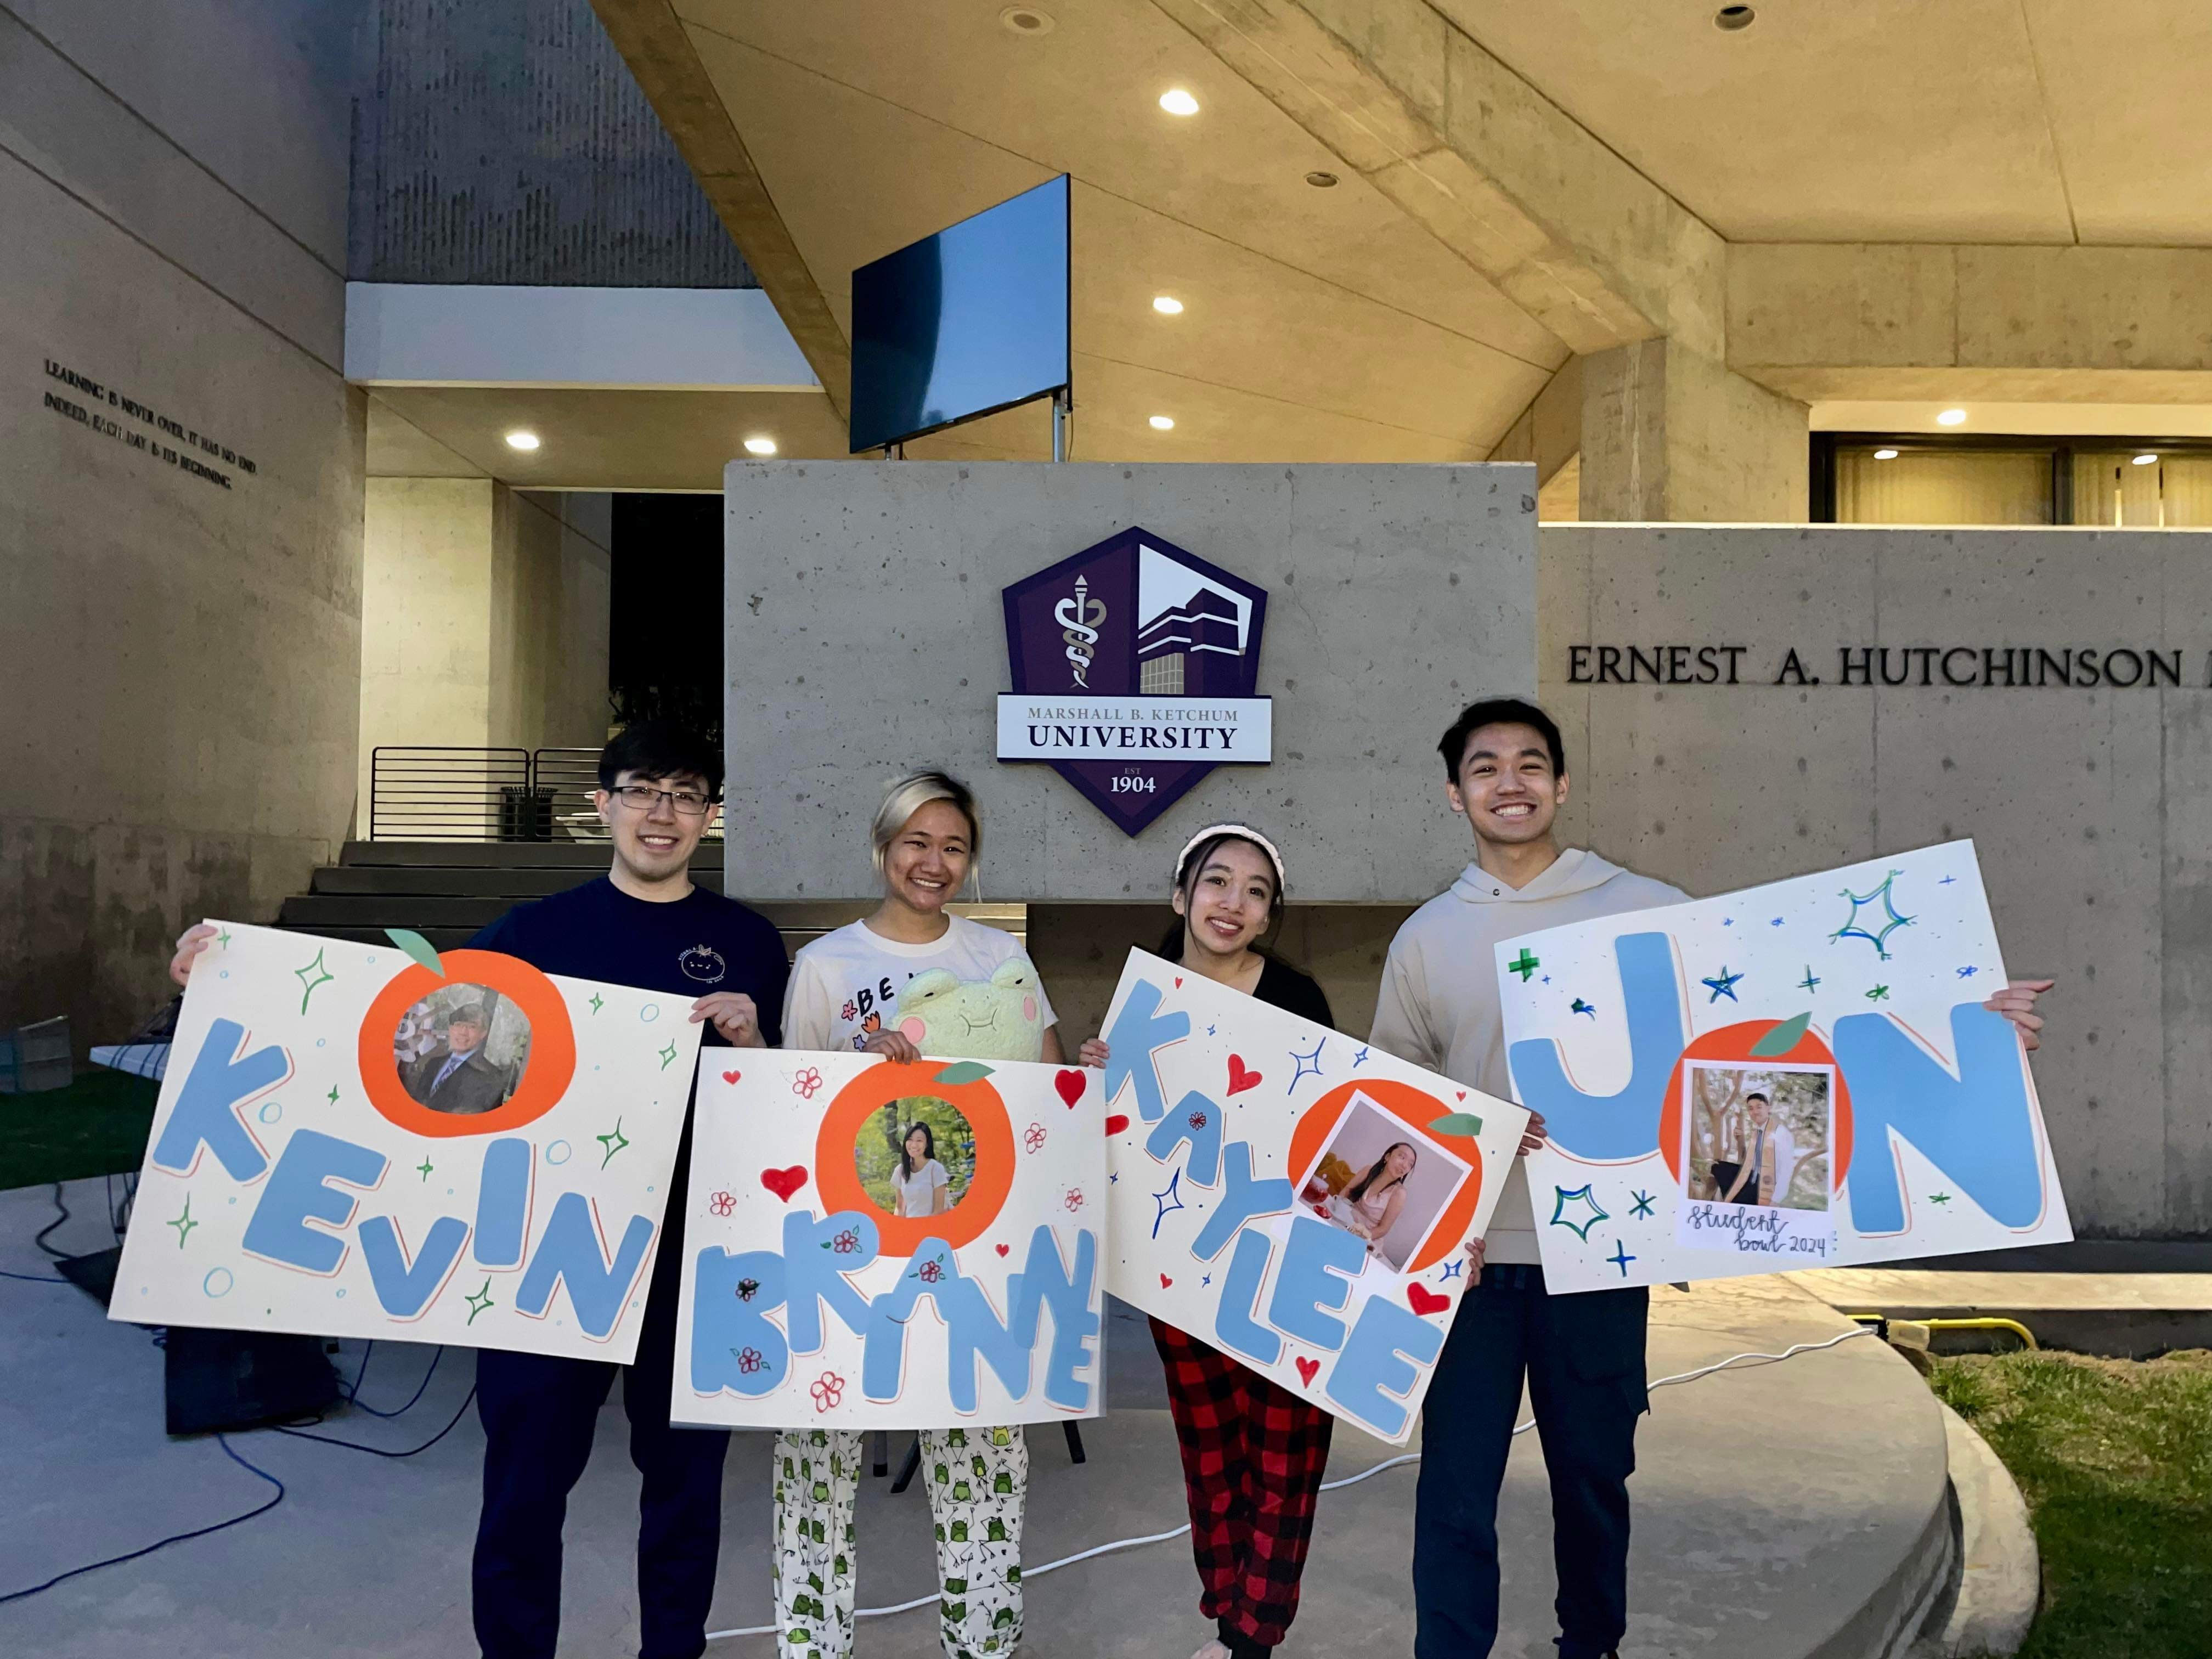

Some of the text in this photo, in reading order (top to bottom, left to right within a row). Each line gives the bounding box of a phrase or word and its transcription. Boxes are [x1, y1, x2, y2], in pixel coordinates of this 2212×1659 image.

[44, 358, 104, 400] LEARNING
[109, 391, 117, 406] IS
[121, 396, 154, 424] NEVER
[157, 416, 185, 442] OVER,
[189, 431, 198, 445] IT
[201, 437, 219, 456] HAS
[222, 447, 235, 464] NO
[93, 414, 122, 439] EACH
[126, 430, 146, 449] DAY
[163, 447, 177, 464] ITS
[1567, 646, 1747, 684] ERNEST
[1774, 647, 1820, 686] A.
[1839, 647, 2183, 687] HUTCHINSON
[1028, 708, 1238, 721] MARSHALL B. KETCHUM
[1027, 725, 1238, 749] UNIVERSITY
[1110, 776, 1156, 793] 1904
[857, 977, 895, 1017] BE
[151, 1018, 656, 1338] KEVIN
[1104, 978, 1445, 1435] KAYLEE
[1688, 1205, 1789, 1234] student
[1790, 1235, 1826, 1257] 2024
